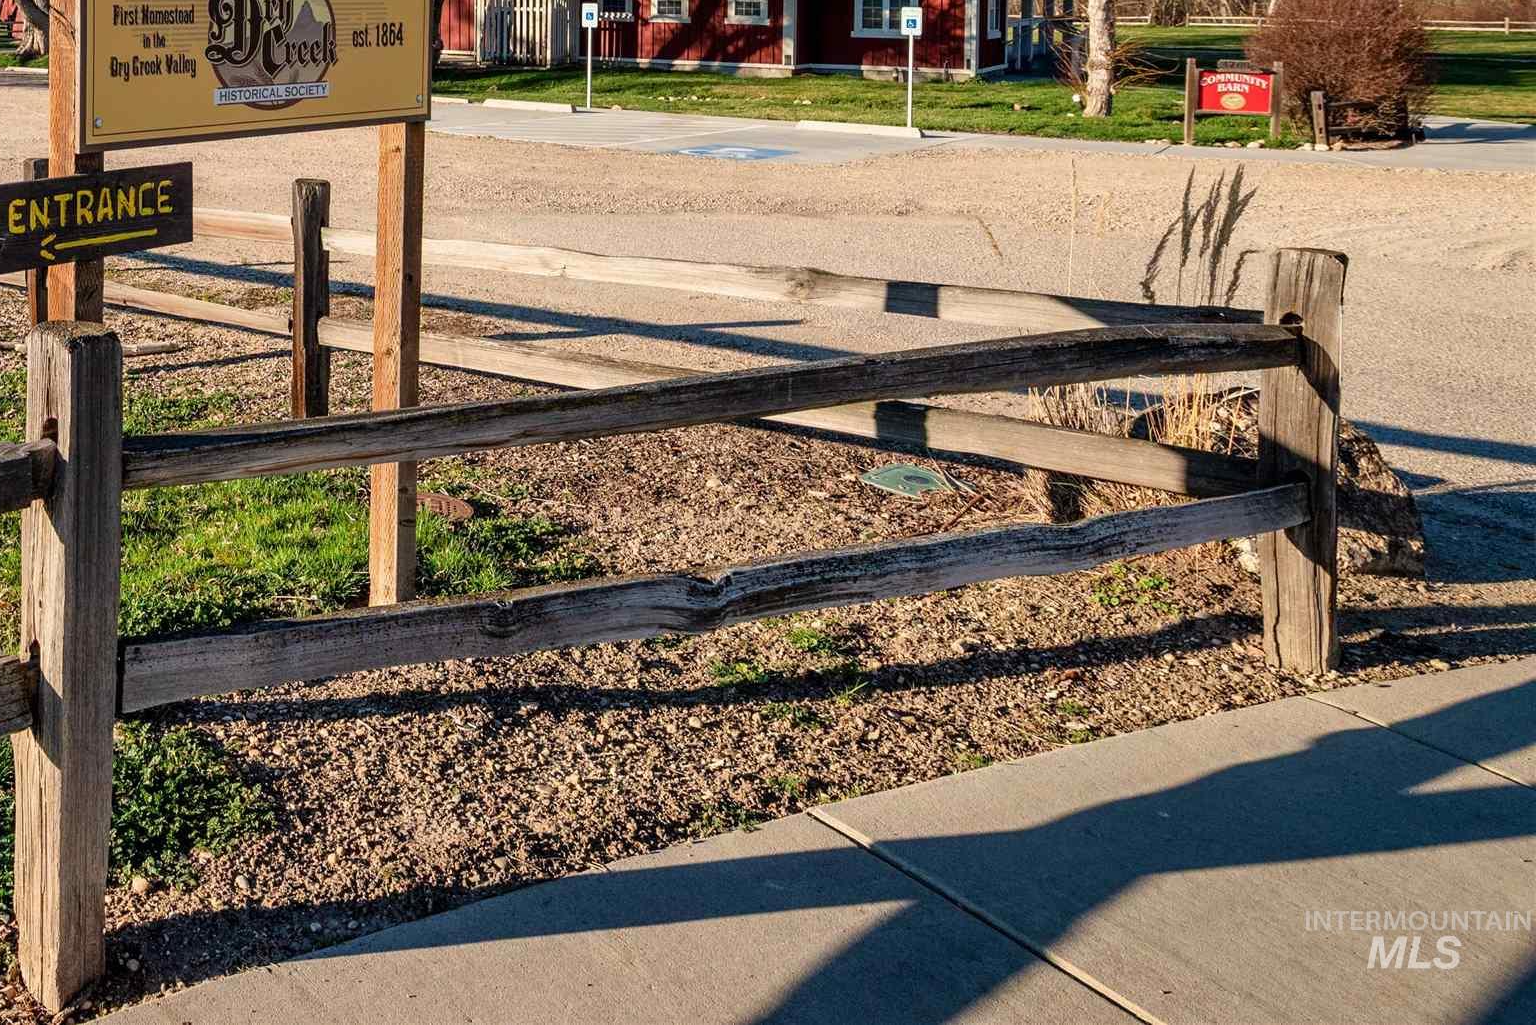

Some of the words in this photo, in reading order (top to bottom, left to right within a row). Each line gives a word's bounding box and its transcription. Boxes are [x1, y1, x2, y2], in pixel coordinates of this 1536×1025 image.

[112, 4, 139, 26] First
[142, 3, 195, 25] Homestead
[143, 33, 151, 48] in
[154, 31, 166, 48] the
[375, 22, 404, 47] 1864
[261, 20, 338, 79] Creek
[110, 56, 130, 82] Dry
[132, 54, 162, 76] Creek
[165, 53, 196, 78] Valley
[219, 86, 282, 102] HISTORICAL
[285, 84, 328, 98] SOCIETY
[1200, 73, 1268, 90] COMMUNITY
[1217, 82, 1249, 94] BARN
[8, 180, 174, 234] ENTRANCE
